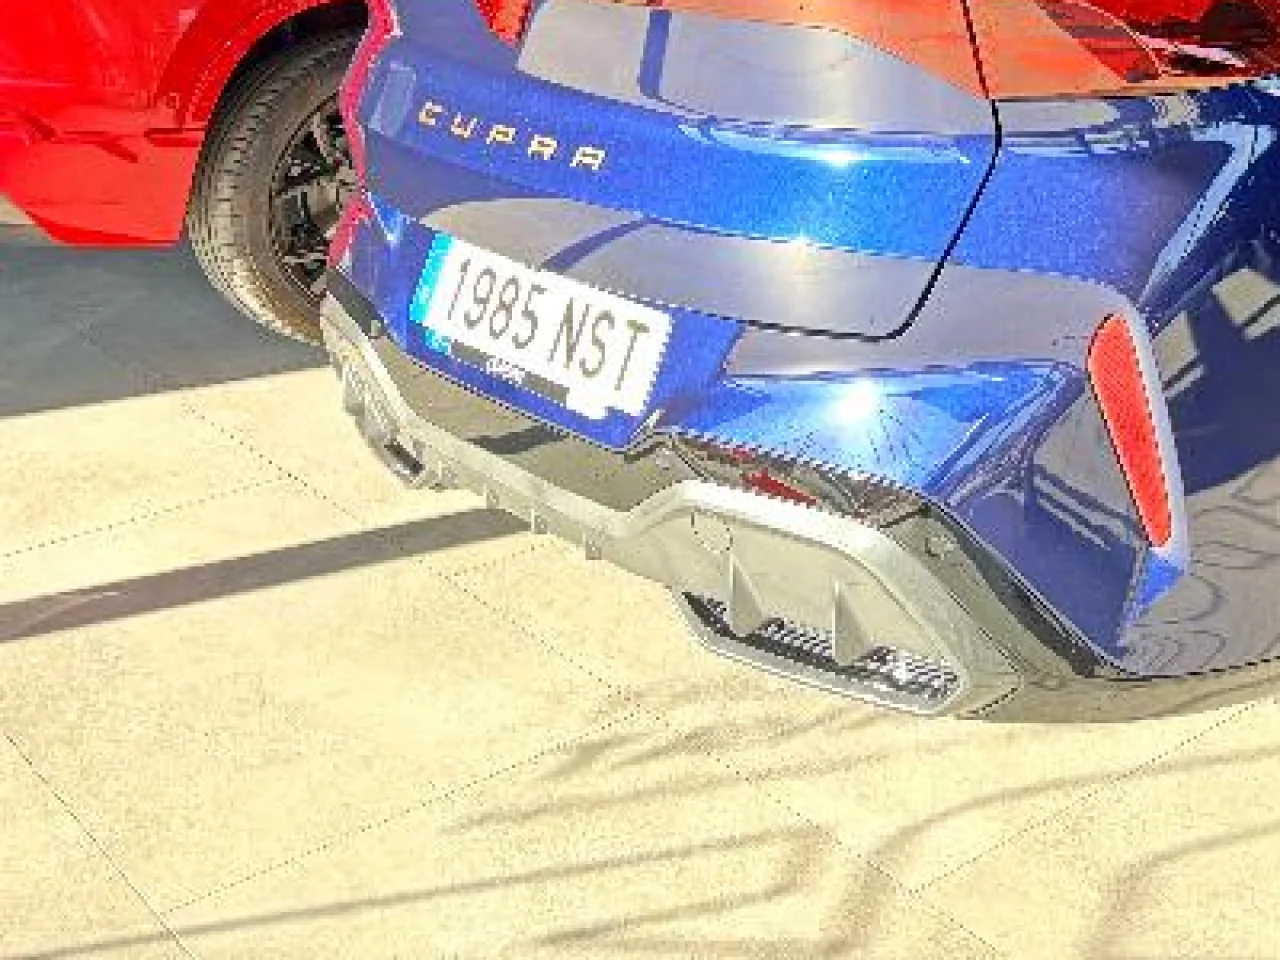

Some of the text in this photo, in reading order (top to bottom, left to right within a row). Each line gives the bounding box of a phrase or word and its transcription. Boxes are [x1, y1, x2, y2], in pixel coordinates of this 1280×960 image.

[418, 100, 607, 170] CUPRA
[448, 258, 651, 392] 1985 NST
